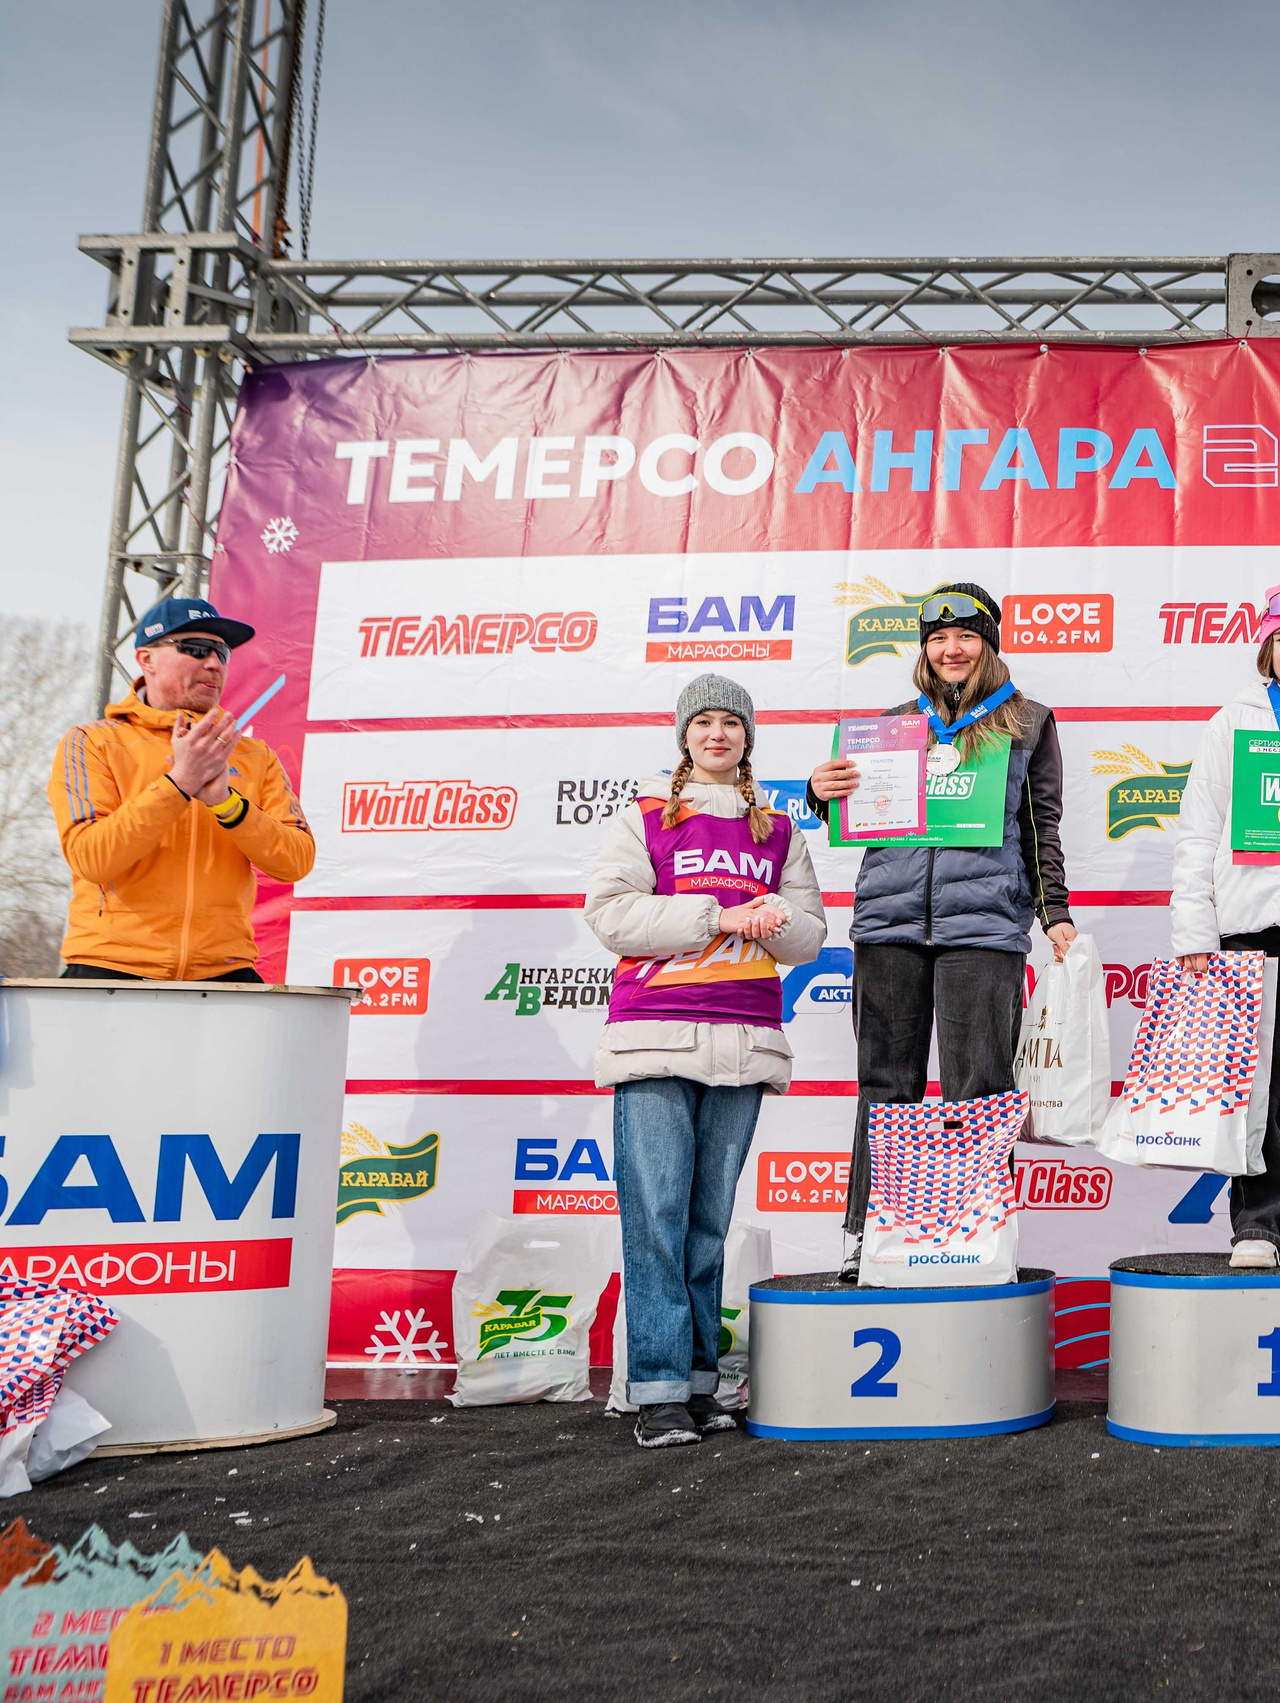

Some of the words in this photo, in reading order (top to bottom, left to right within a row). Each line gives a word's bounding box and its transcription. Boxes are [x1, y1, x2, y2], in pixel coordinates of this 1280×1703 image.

[335, 431, 775, 505] ТЕМЕРСО
[793, 427, 1179, 493] АНГАРА
[646, 595, 797, 634] БАМ
[667, 640, 771, 661] МАРАФОНЫ
[348, 785, 427, 826] World
[429, 784, 512, 826] Class
[556, 803, 631, 825] LOP
[674, 848, 773, 885] БАМ
[690, 876, 759, 894] МАРАФОНЫ
[1135, 1131, 1201, 1147] росбанк
[515, 1138, 618, 1181] БА
[0, 1133, 301, 1226] АМ
[341, 1169, 429, 1190] КАРАВАЙ
[1028, 1168, 1108, 1205] Class
[537, 1193, 620, 1212] МАРАФО
[908, 1250, 981, 1267] росбанк
[494, 1351, 513, 1359] ЛЕТ
[513, 1349, 547, 1358] ВМЕСТЕ
[850, 1327, 902, 1398] 2
[31, 1612, 56, 1638] 2
[159, 1641, 172, 1667] 1
[179, 1633, 298, 1667] МЕСТО
